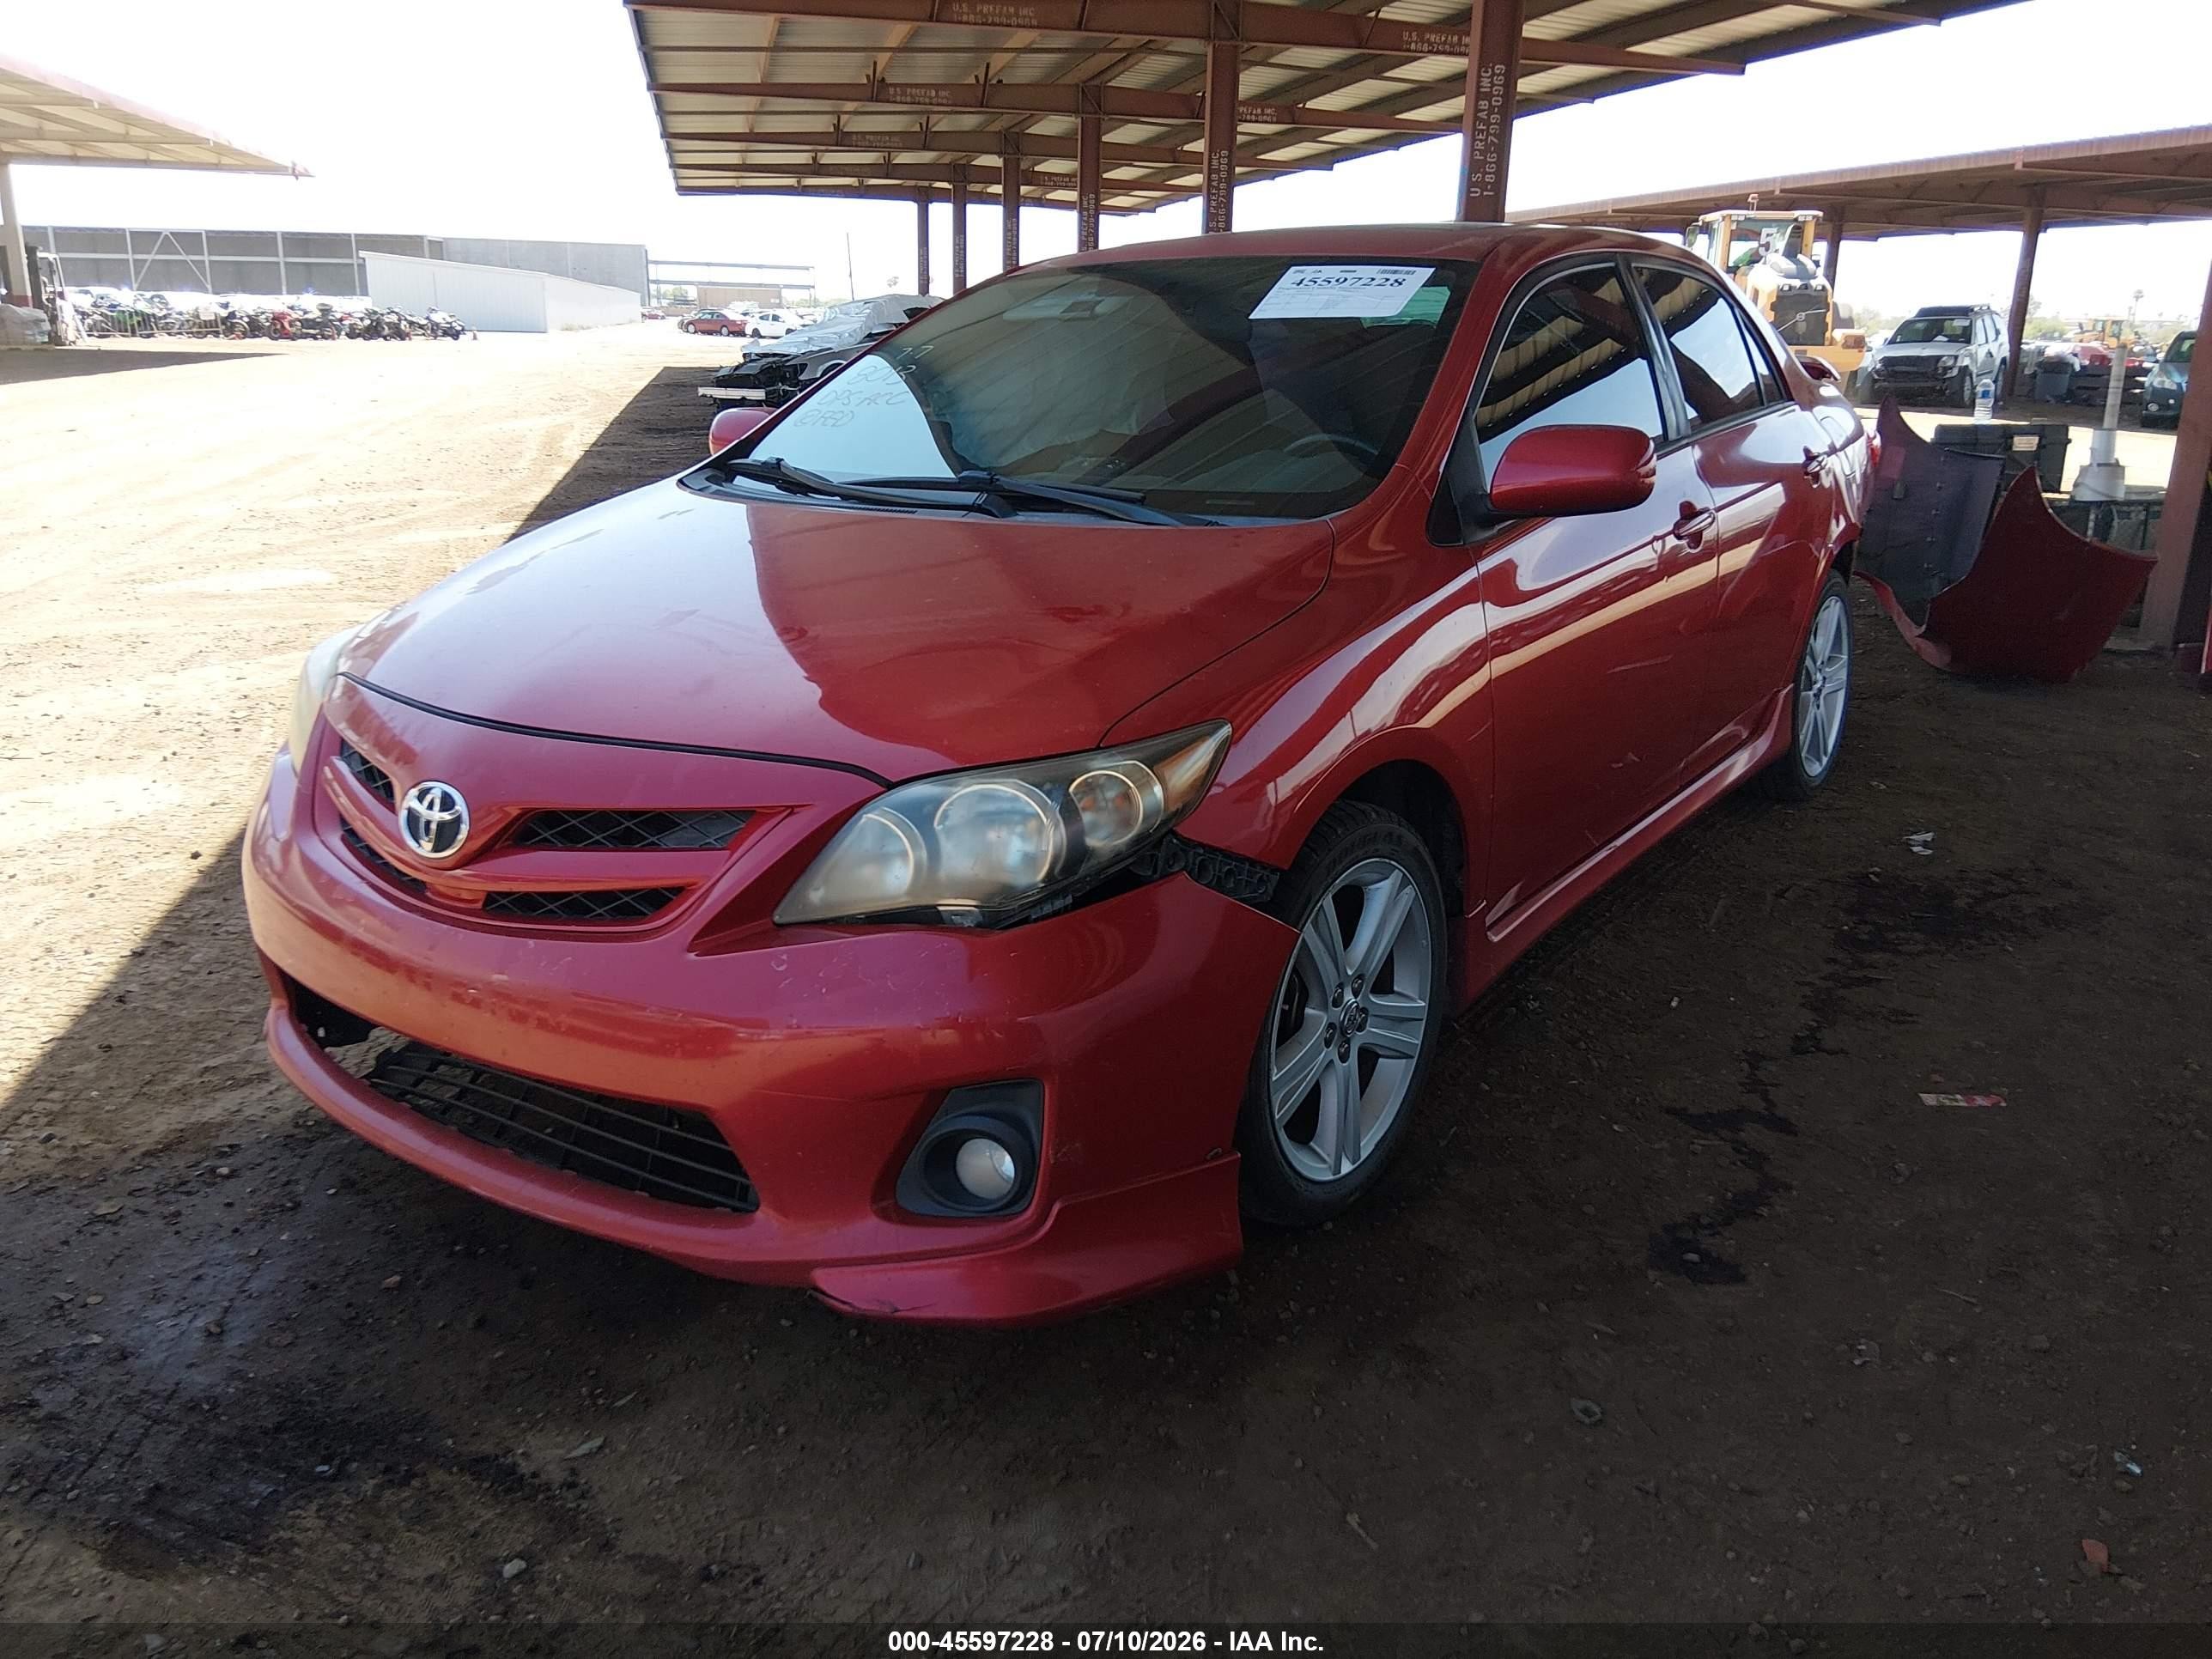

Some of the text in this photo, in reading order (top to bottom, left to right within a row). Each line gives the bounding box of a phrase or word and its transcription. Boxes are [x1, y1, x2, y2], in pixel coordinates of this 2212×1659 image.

[1423, 33, 1459, 45] PREFAB
[1479, 62, 1493, 93] INC.
[1473, 99, 1489, 160] PREFAB
[1483, 64, 1505, 198] 1-866-799-0969
[1210, 148, 1221, 169] INC.
[1081, 191, 1090, 208] INC.
[1209, 173, 1219, 213] PREFAB
[1217, 149, 1229, 234] -866-799-0969
[1759, 228, 1778, 256] 5
[1291, 276, 1407, 288] 45597228
